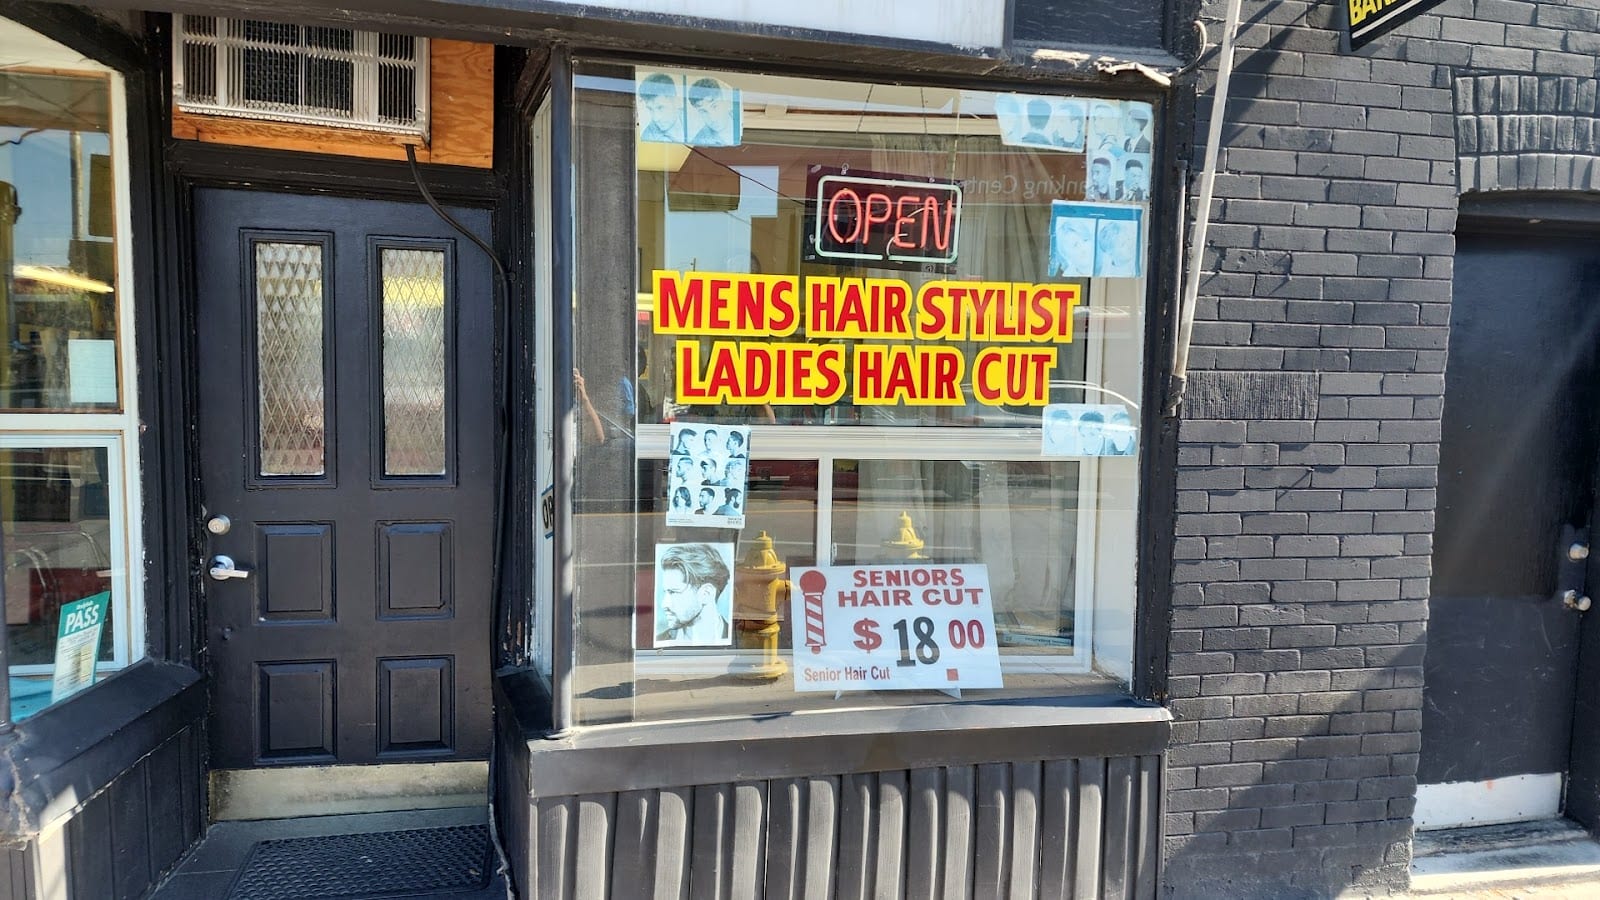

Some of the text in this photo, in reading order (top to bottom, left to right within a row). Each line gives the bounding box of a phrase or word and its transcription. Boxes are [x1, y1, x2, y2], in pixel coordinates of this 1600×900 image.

[1349, 0, 1398, 26] BA
[828, 188, 953, 250] OPEN
[659, 277, 1075, 337] MENS HAIR STYLIST
[683, 346, 1051, 401] LADIES HAIR CUT
[853, 568, 965, 588] SENIORS
[838, 588, 984, 608] HAIR CUT
[64, 604, 100, 635] PASS
[853, 616, 985, 667] $ 18 00
[804, 665, 891, 682] Senior Hair Cut
